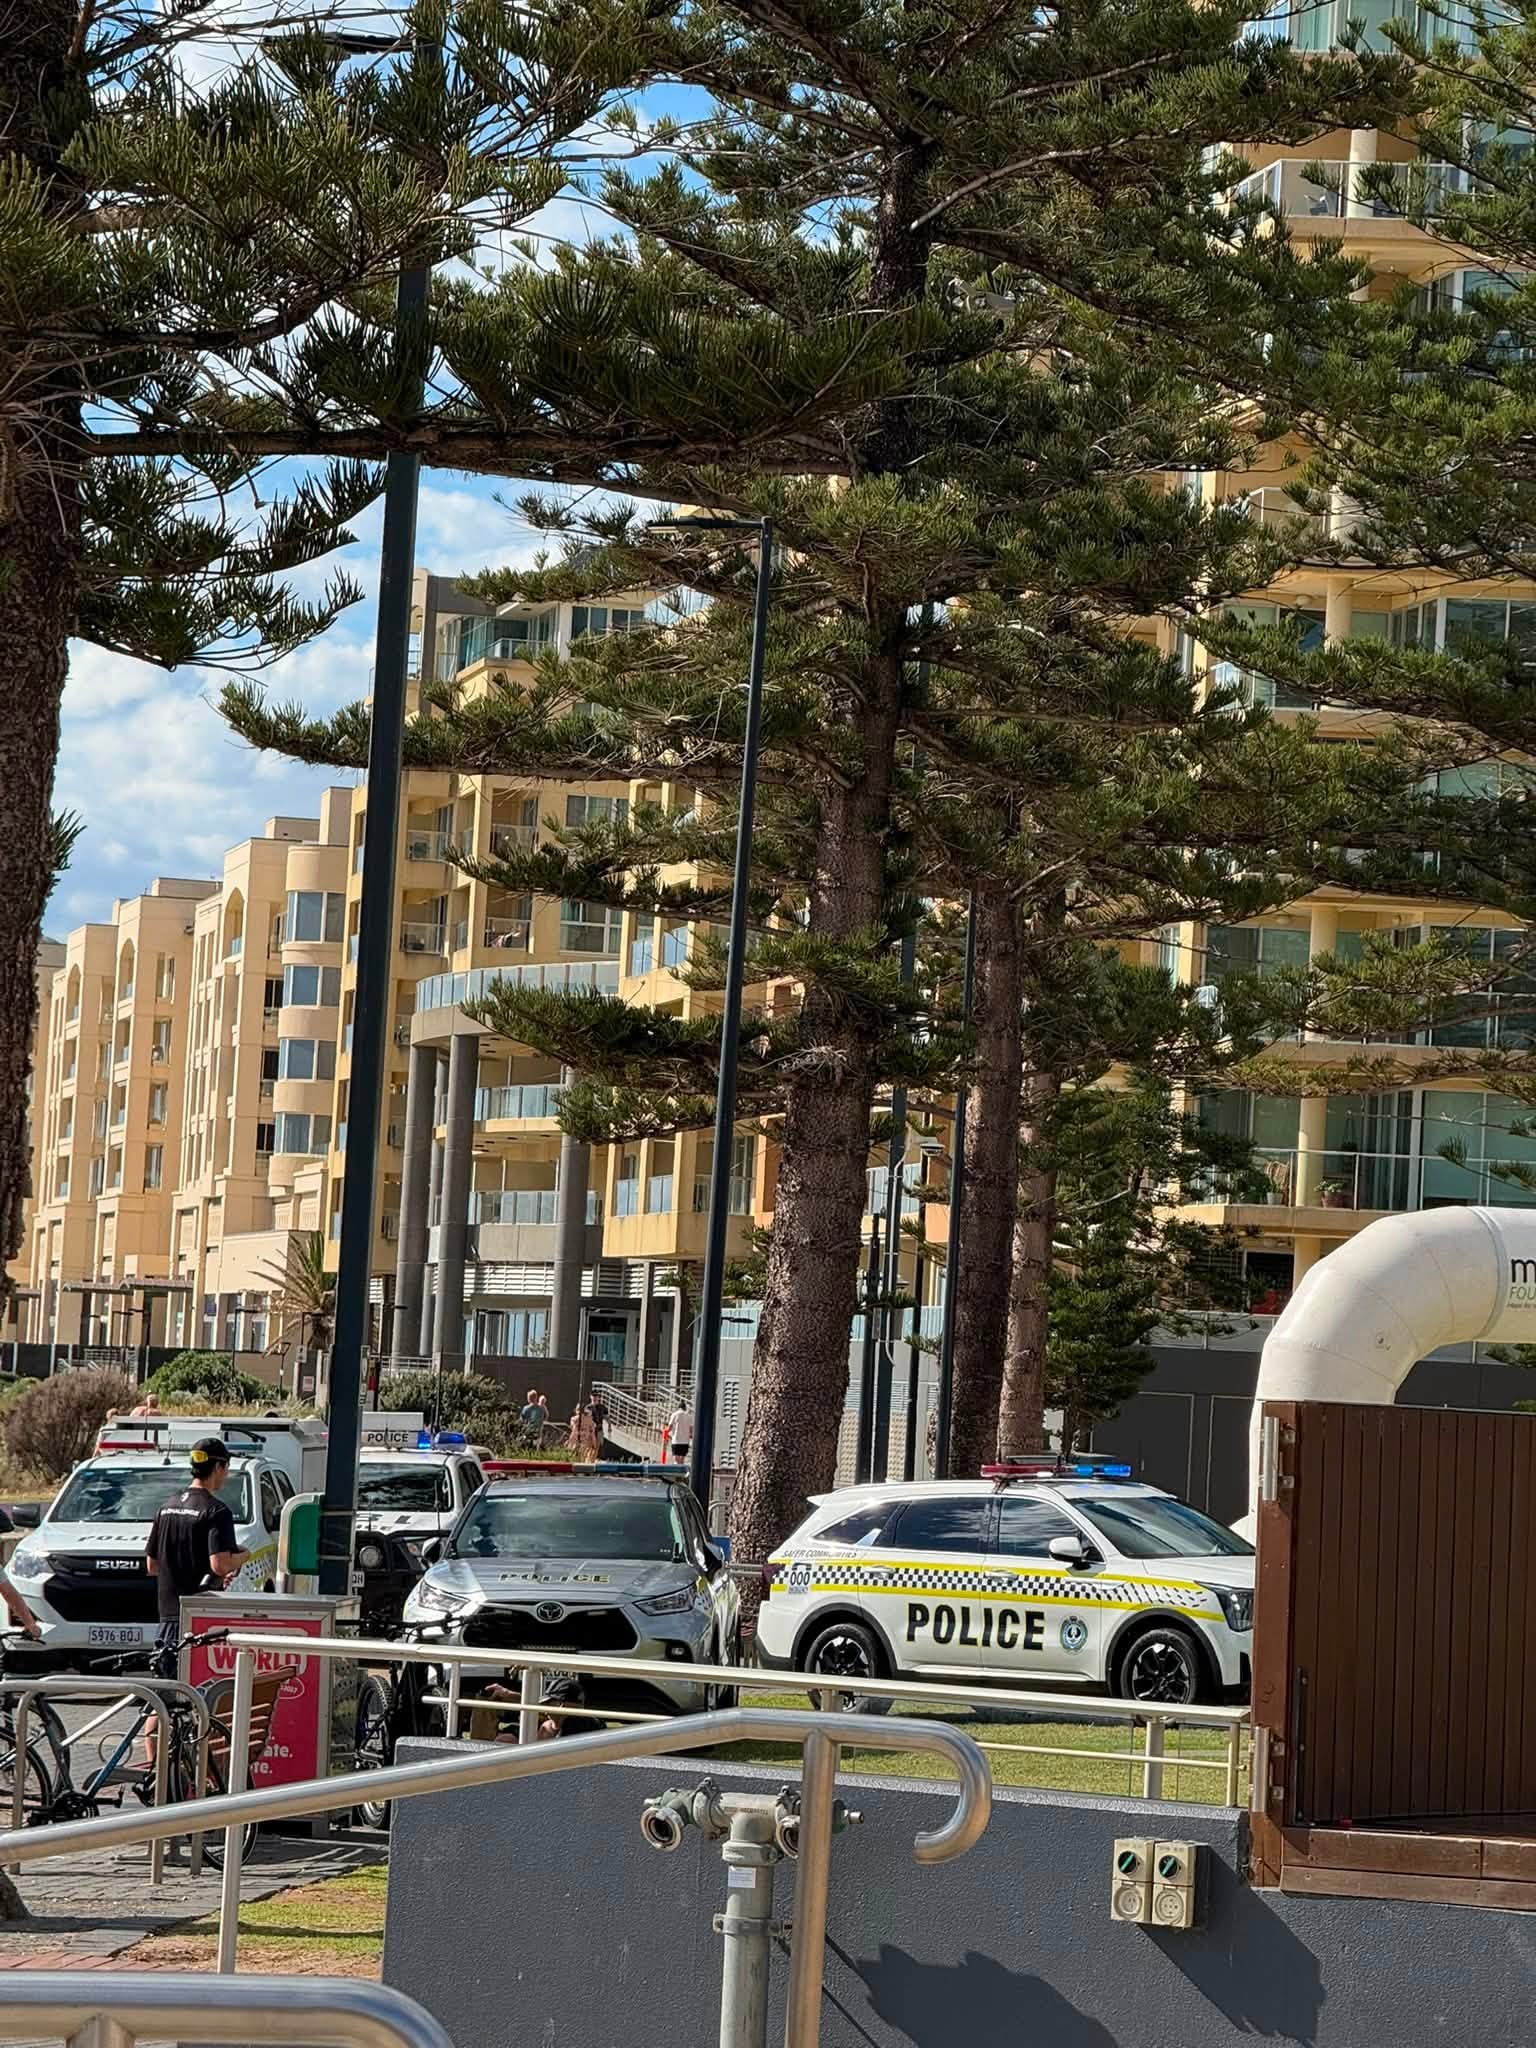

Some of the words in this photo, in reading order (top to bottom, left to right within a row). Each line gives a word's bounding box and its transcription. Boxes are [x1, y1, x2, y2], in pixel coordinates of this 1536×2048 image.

[95, 1560, 140, 1569] ISUZU
[498, 1571, 609, 1584] POLICE
[790, 1571, 811, 1586] 000
[906, 1603, 1045, 1651] POLICE
